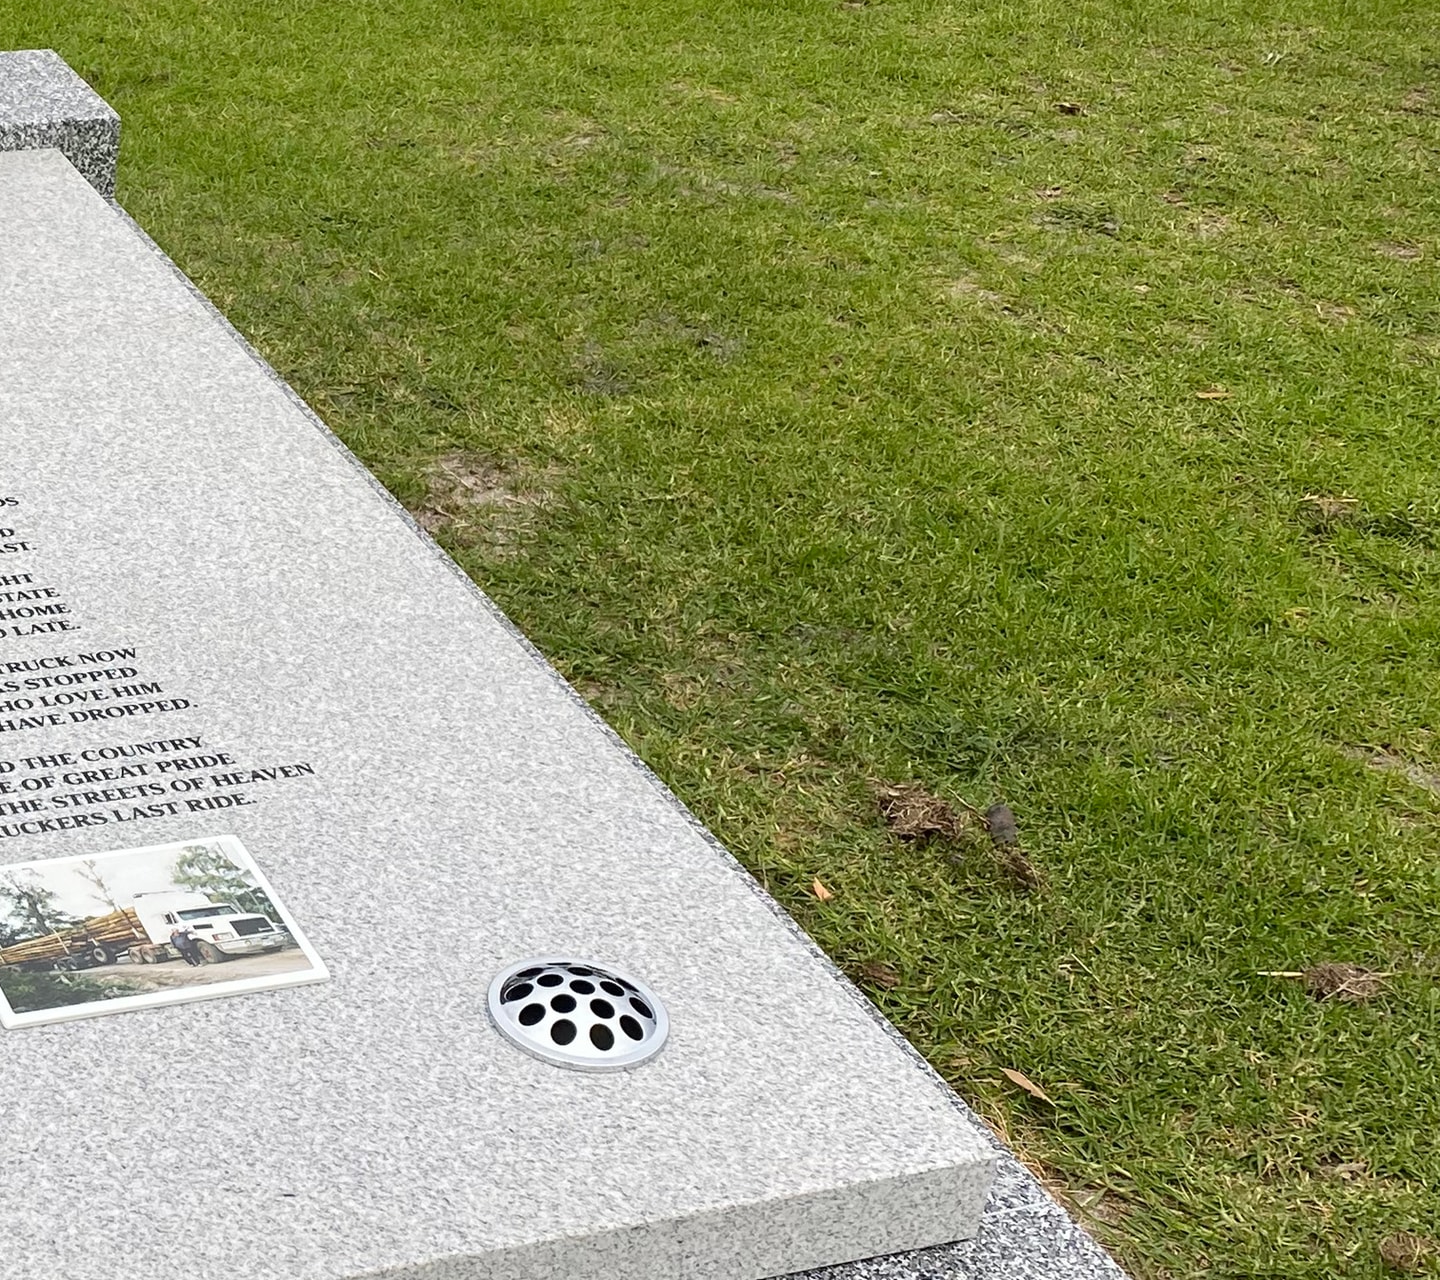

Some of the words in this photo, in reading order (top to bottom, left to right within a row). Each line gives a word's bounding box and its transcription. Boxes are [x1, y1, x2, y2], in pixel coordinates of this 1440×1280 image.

[12, 619, 81, 637] LATE.
[78, 648, 138, 666] NOW
[25, 667, 138, 690] STOPPED
[40, 689, 109, 708] LOVE
[112, 682, 162, 698] HIM
[70, 698, 199, 724] DROPPED.
[19, 753, 77, 770] THE
[81, 736, 203, 762] COUNTRY
[21, 776, 55, 791] OF
[63, 763, 148, 786] GREAT
[156, 753, 236, 773] PRIDE
[51, 783, 165, 808] STREETS
[170, 777, 206, 793] OF
[213, 763, 315, 787] HEAVEN
[113, 801, 178, 822] LAST
[185, 793, 257, 813] RIDE.
